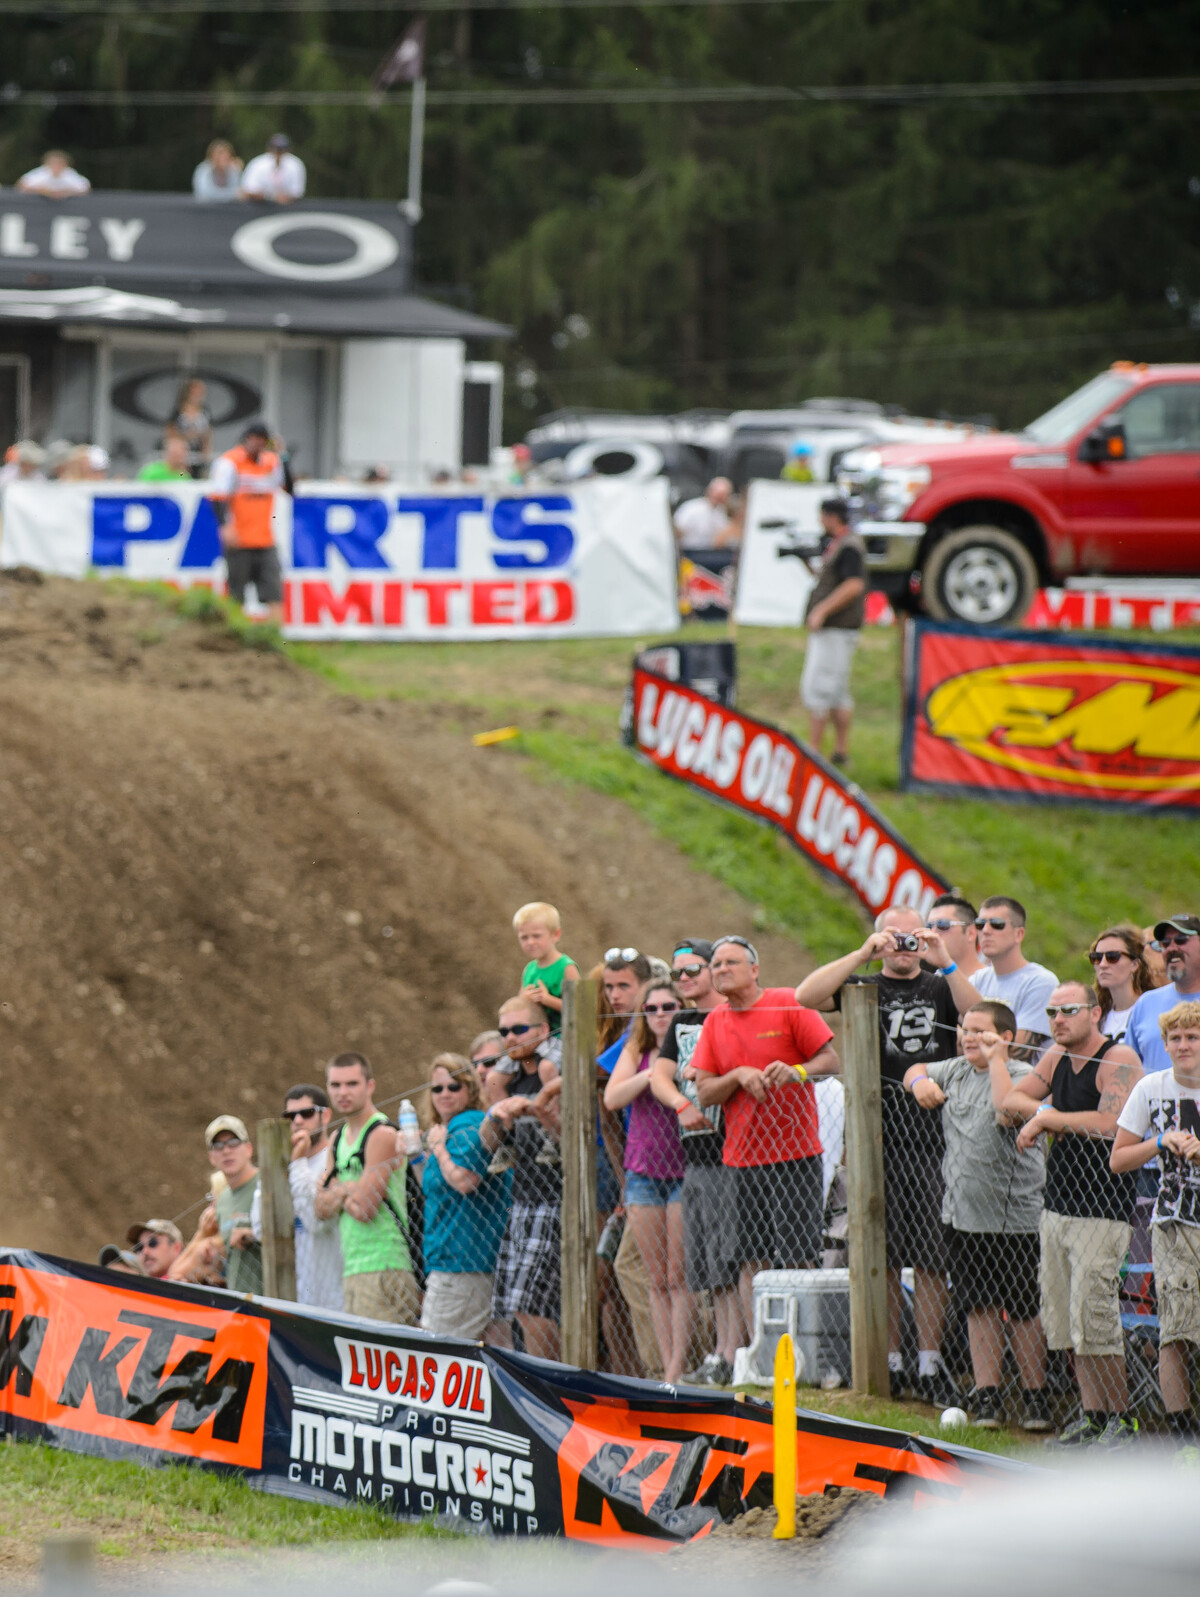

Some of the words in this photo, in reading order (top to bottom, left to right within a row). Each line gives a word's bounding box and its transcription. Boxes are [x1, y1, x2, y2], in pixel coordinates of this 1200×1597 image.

[638, 682, 745, 789] LUCAS
[741, 732, 798, 819] OIL
[797, 774, 898, 908] LUCAS
[887, 1006, 936, 1039] 13
[57, 1309, 254, 1444] KTM
[348, 1344, 439, 1403] LUCAS
[442, 1361, 486, 1413] OIL
[380, 1404, 447, 1437] PRO
[289, 1408, 536, 1513] MOTOCROSS
[288, 1462, 539, 1535] CHAMPIONSHIP
